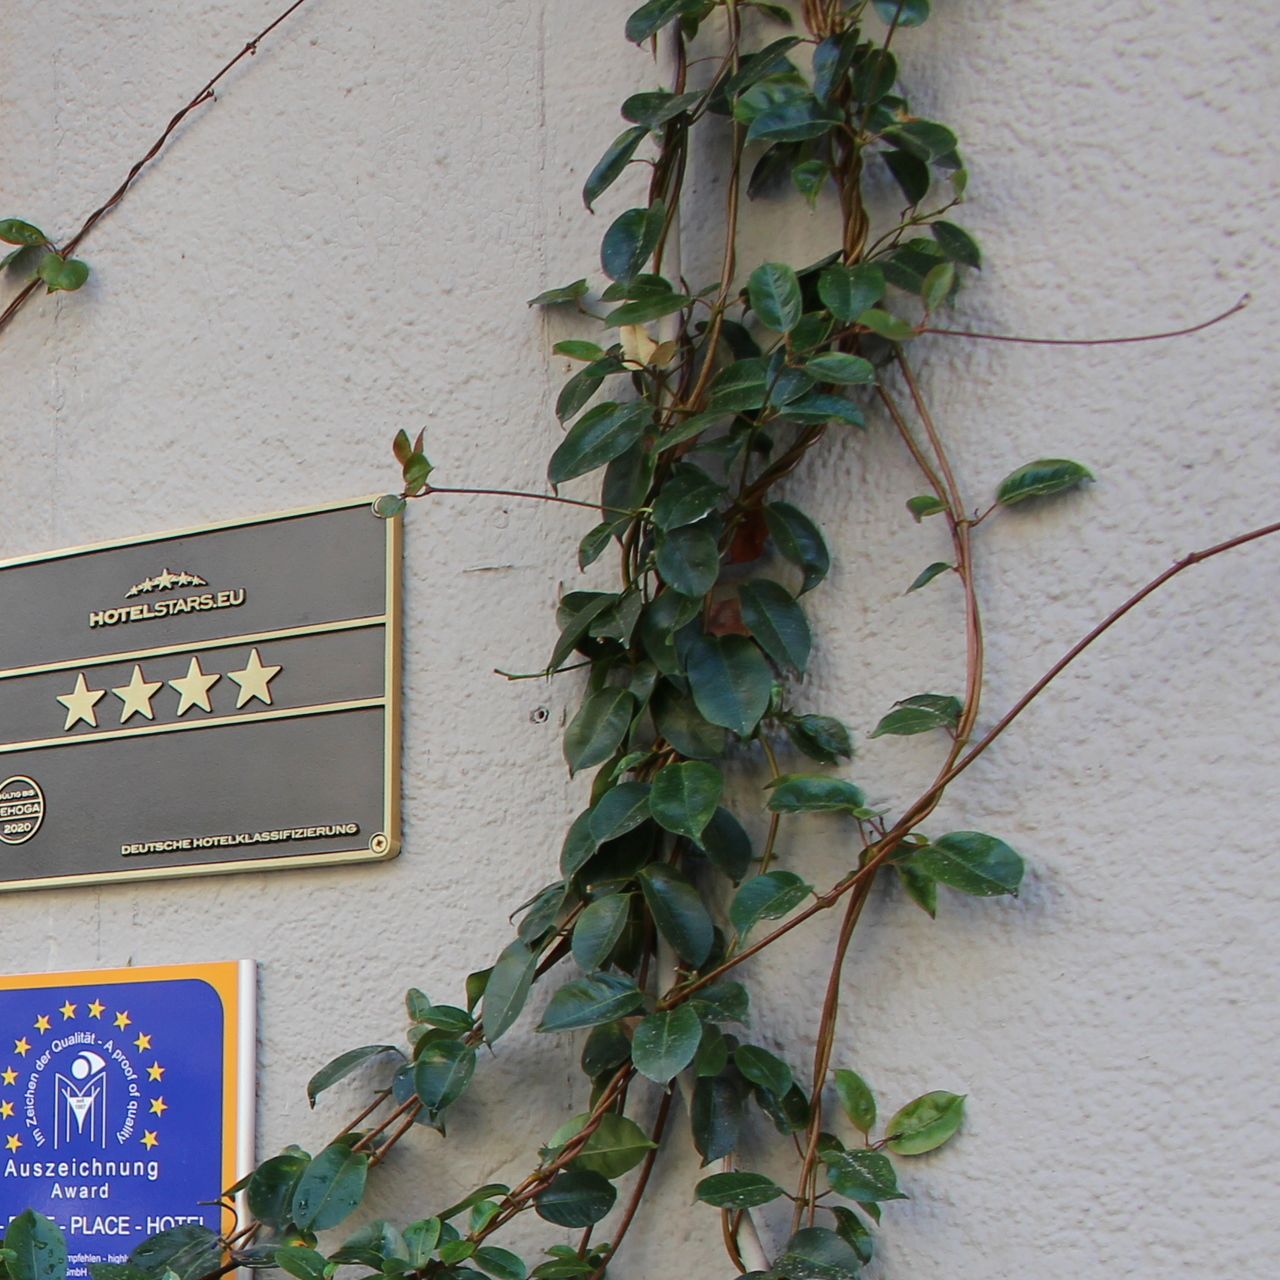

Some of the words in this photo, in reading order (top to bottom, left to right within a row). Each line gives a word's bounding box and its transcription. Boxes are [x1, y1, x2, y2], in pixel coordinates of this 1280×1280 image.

[89, 588, 245, 627] HOTELSTARS.EU
[3, 822, 32, 834] 2020
[121, 838, 191, 855] DEUTSCHE
[193, 823, 358, 849] HOTELKLASSIFIZIERUNG
[51, 1031, 96, 1053] Qualität
[103, 1039, 114, 1053] A
[35, 1050, 52, 1072] der
[111, 1049, 138, 1081] proof
[24, 1072, 40, 1128] Zeichen
[128, 1083, 141, 1097] of
[116, 1100, 138, 1145] quality
[32, 1128, 46, 1148] Im
[4, 1158, 160, 1181] Auszeichnung
[50, 1182, 110, 1199] Award
[71, 1216, 131, 1235] PLACE
